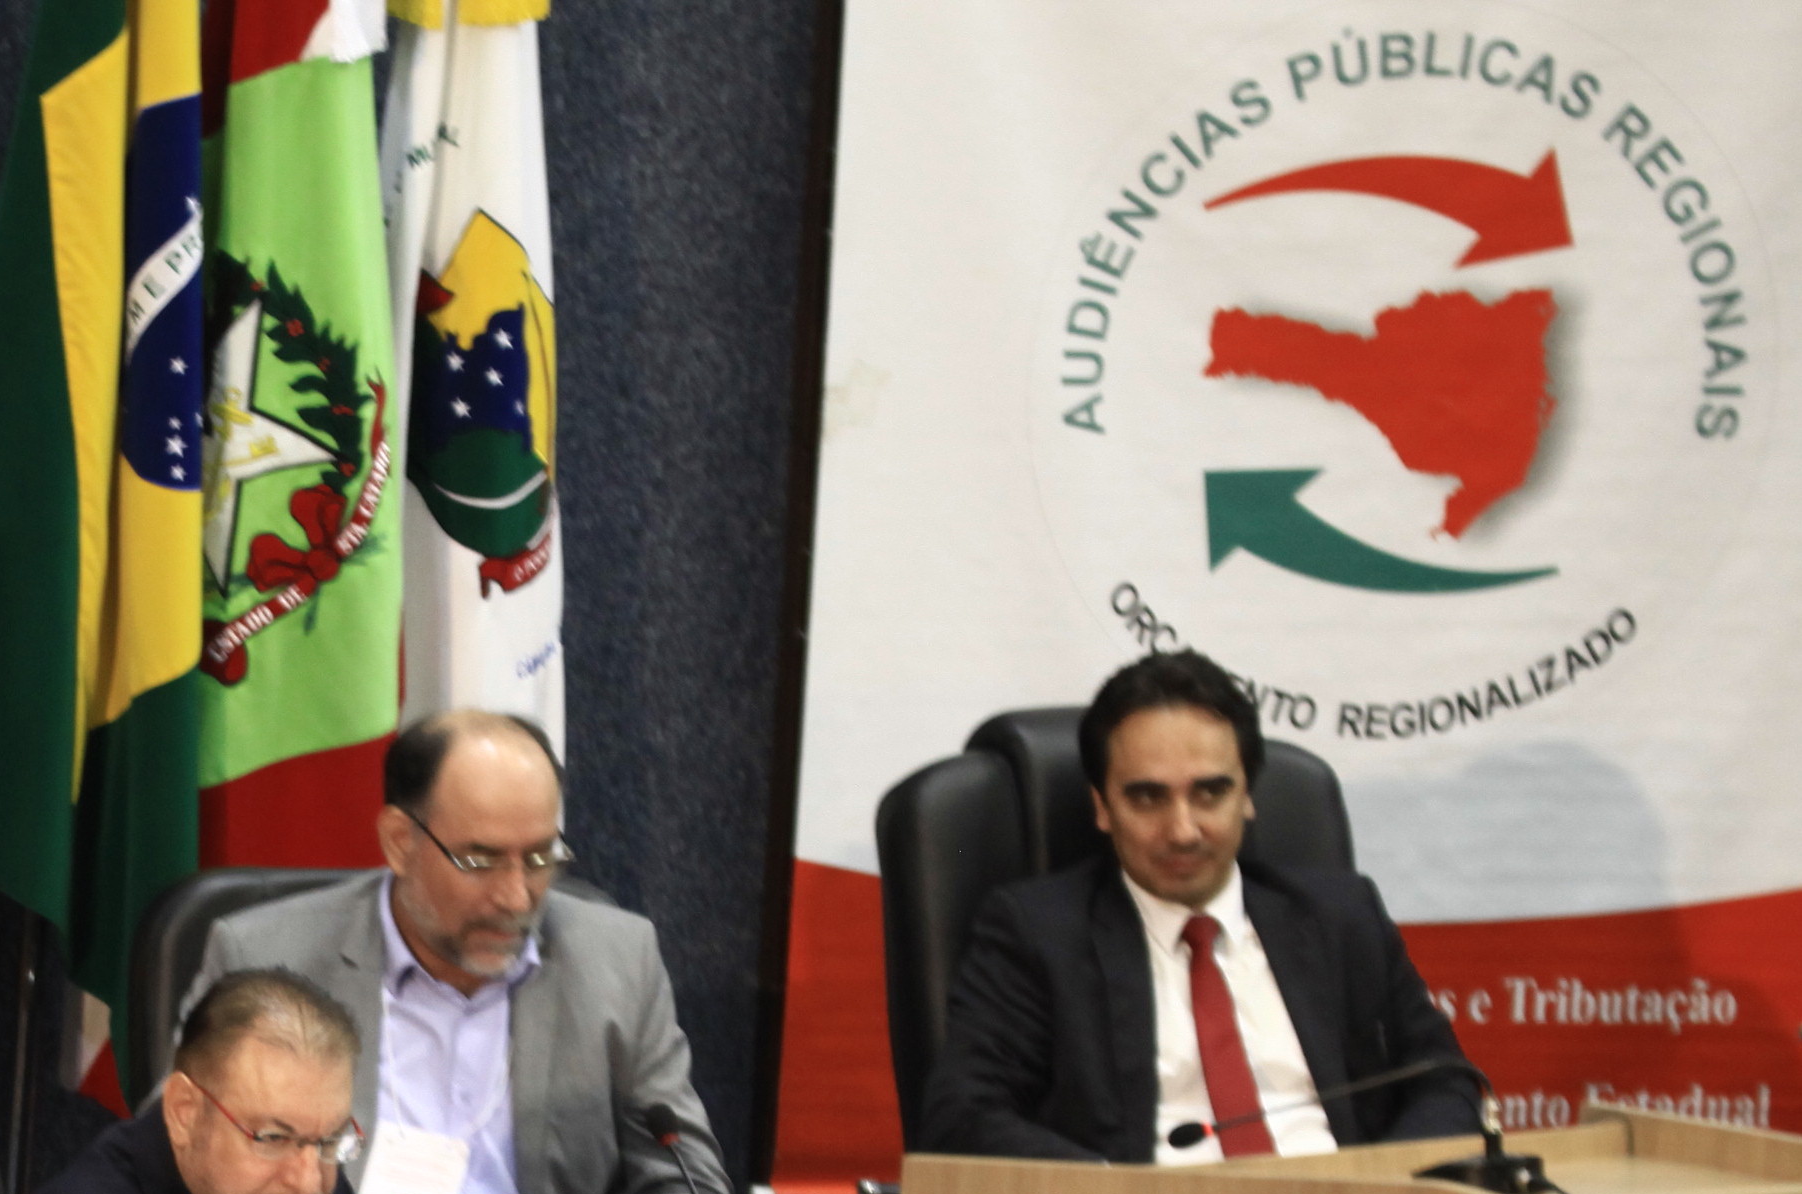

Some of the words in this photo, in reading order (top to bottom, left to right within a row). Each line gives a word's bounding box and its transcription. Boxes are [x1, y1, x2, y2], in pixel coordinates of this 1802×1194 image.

[1060, 79, 1273, 435] AUDIÊNCIAS
[1285, 27, 1602, 122] PÚBLICAS
[1602, 103, 1747, 440] REGIONAIS
[1337, 606, 1638, 740] REGIONALIZADO
[1504, 976, 1739, 1034] Tributação
